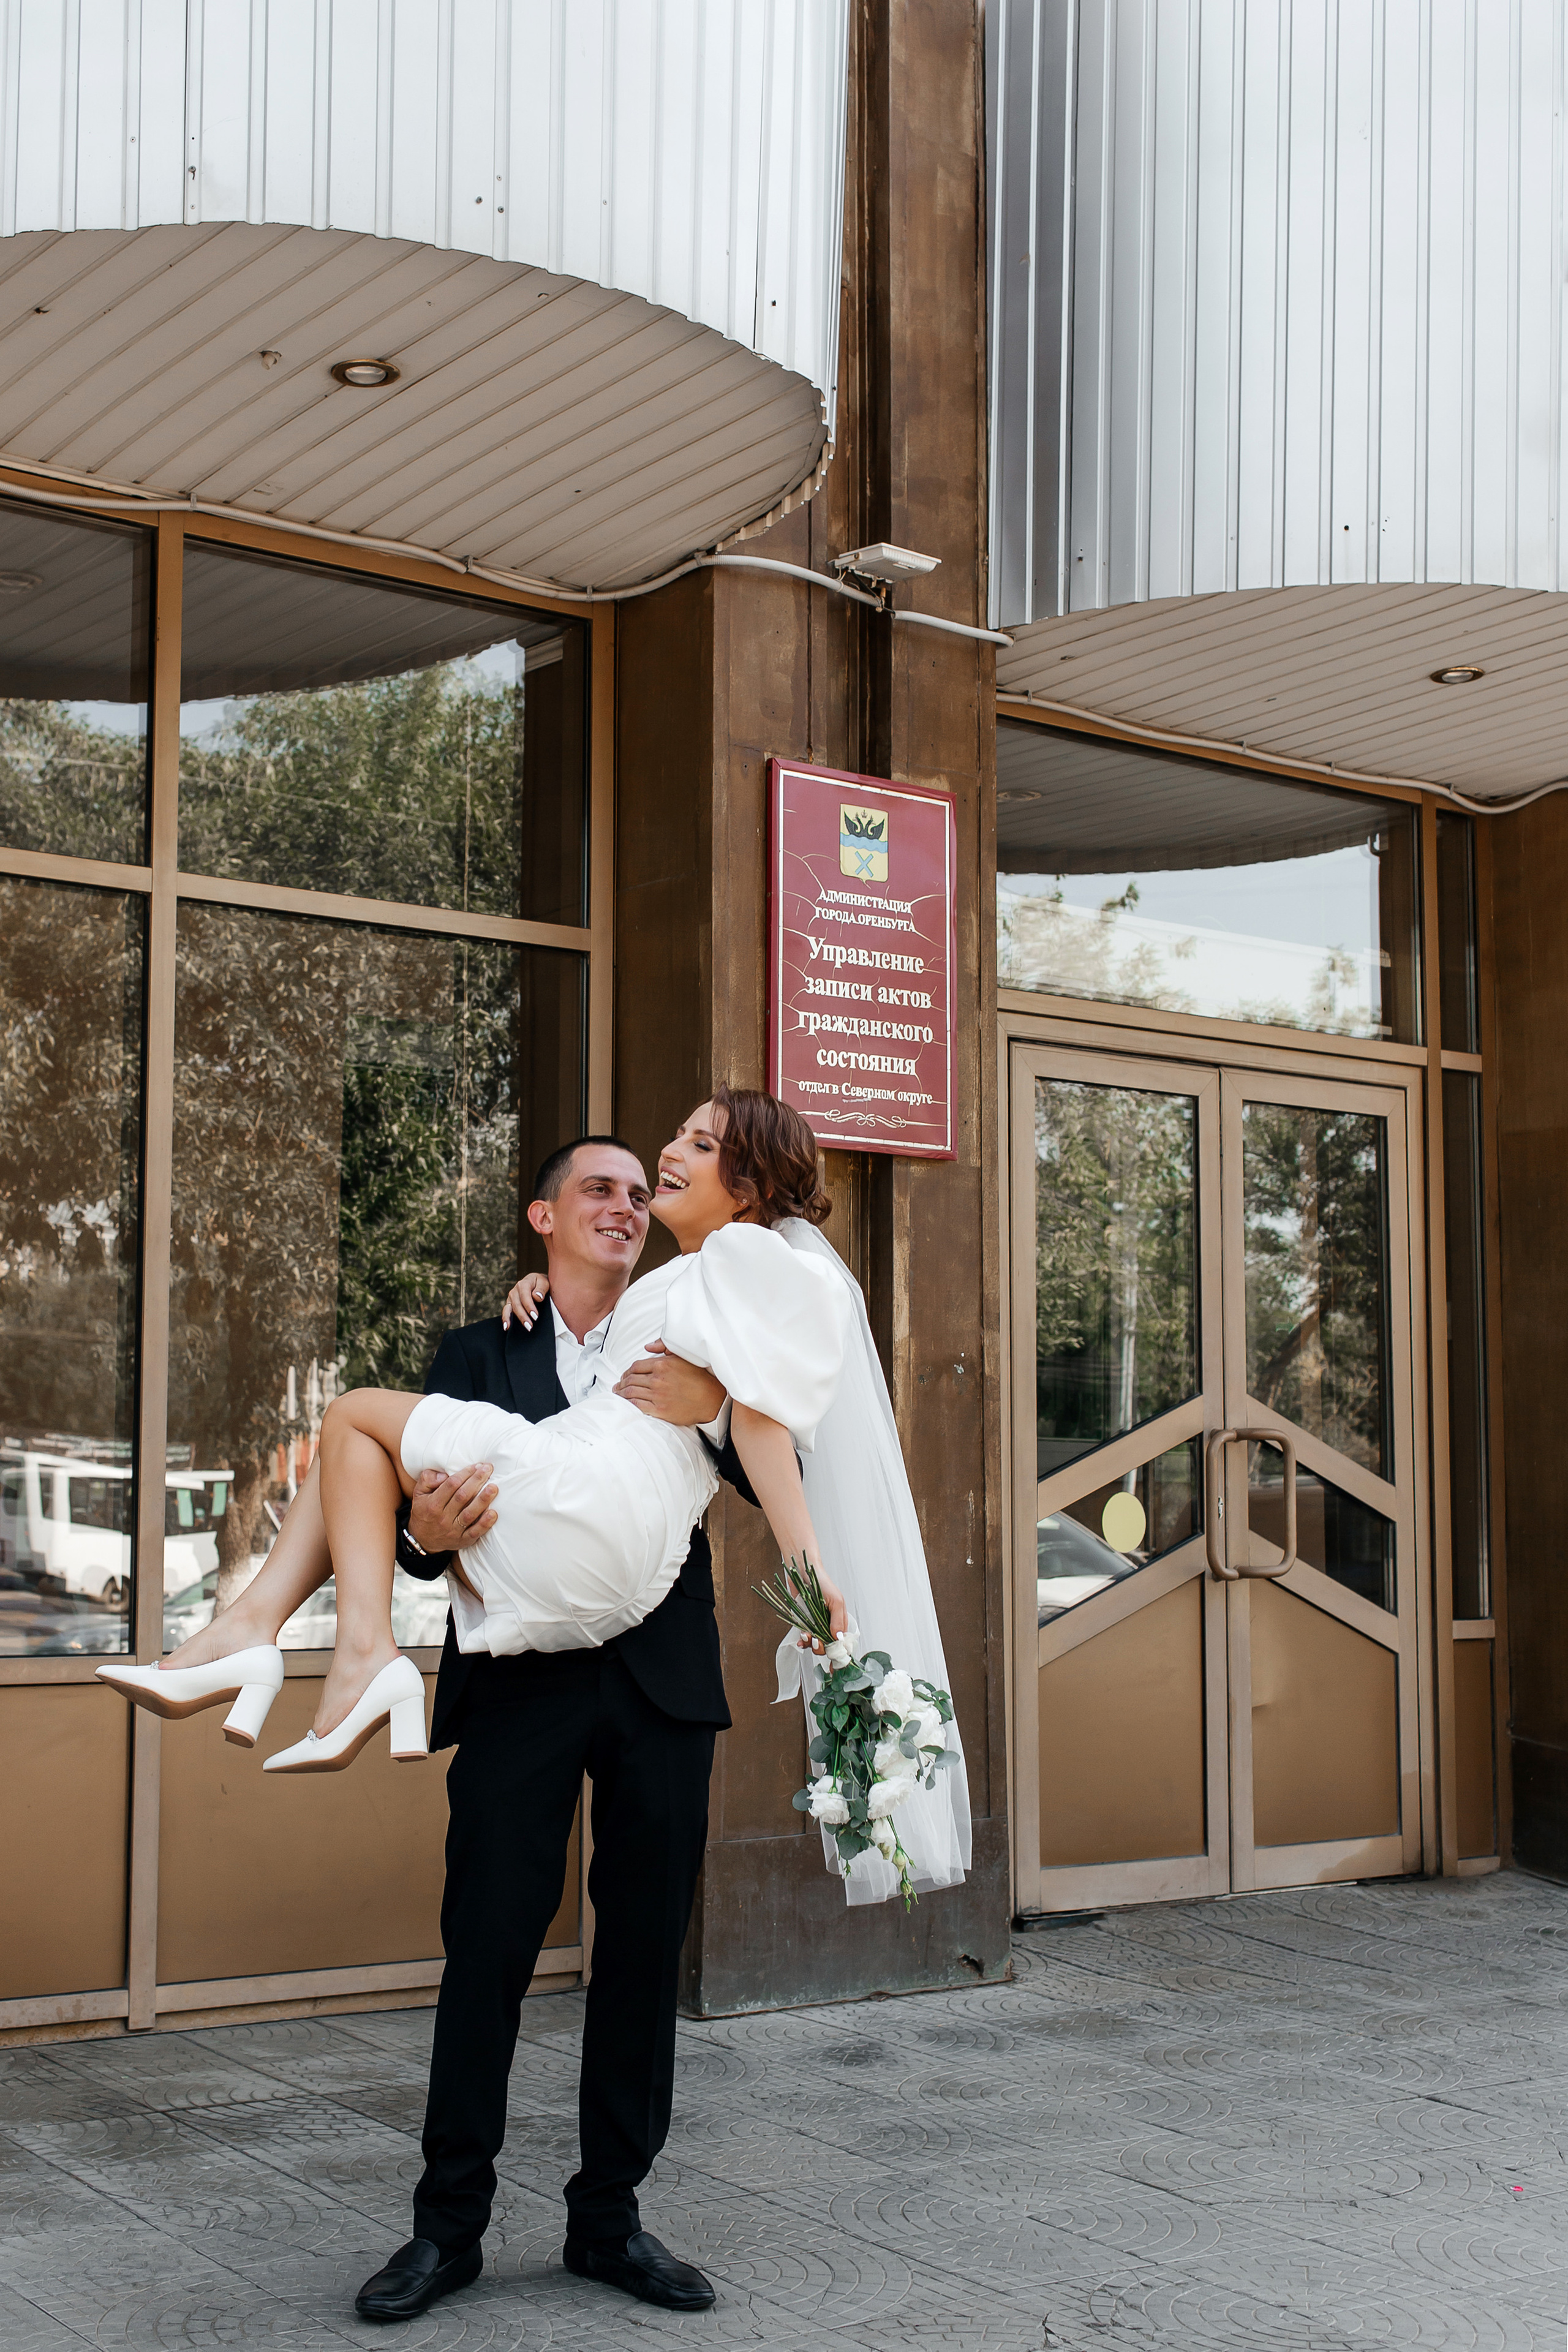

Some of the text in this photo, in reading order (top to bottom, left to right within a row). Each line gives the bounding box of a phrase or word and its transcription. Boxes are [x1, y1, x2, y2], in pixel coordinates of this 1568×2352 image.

[818, 890, 911, 914] АДМИНИСТРАЦИЯ
[816, 907, 916, 932] ГОРОДА ОРЕНБУРГА
[808, 936, 924, 973] Управление
[805, 977, 932, 1009] записи актов
[799, 1011, 933, 1043] гражданского
[816, 1049, 916, 1075] состояния
[798, 1080, 933, 1106] отдел в Северном округе
